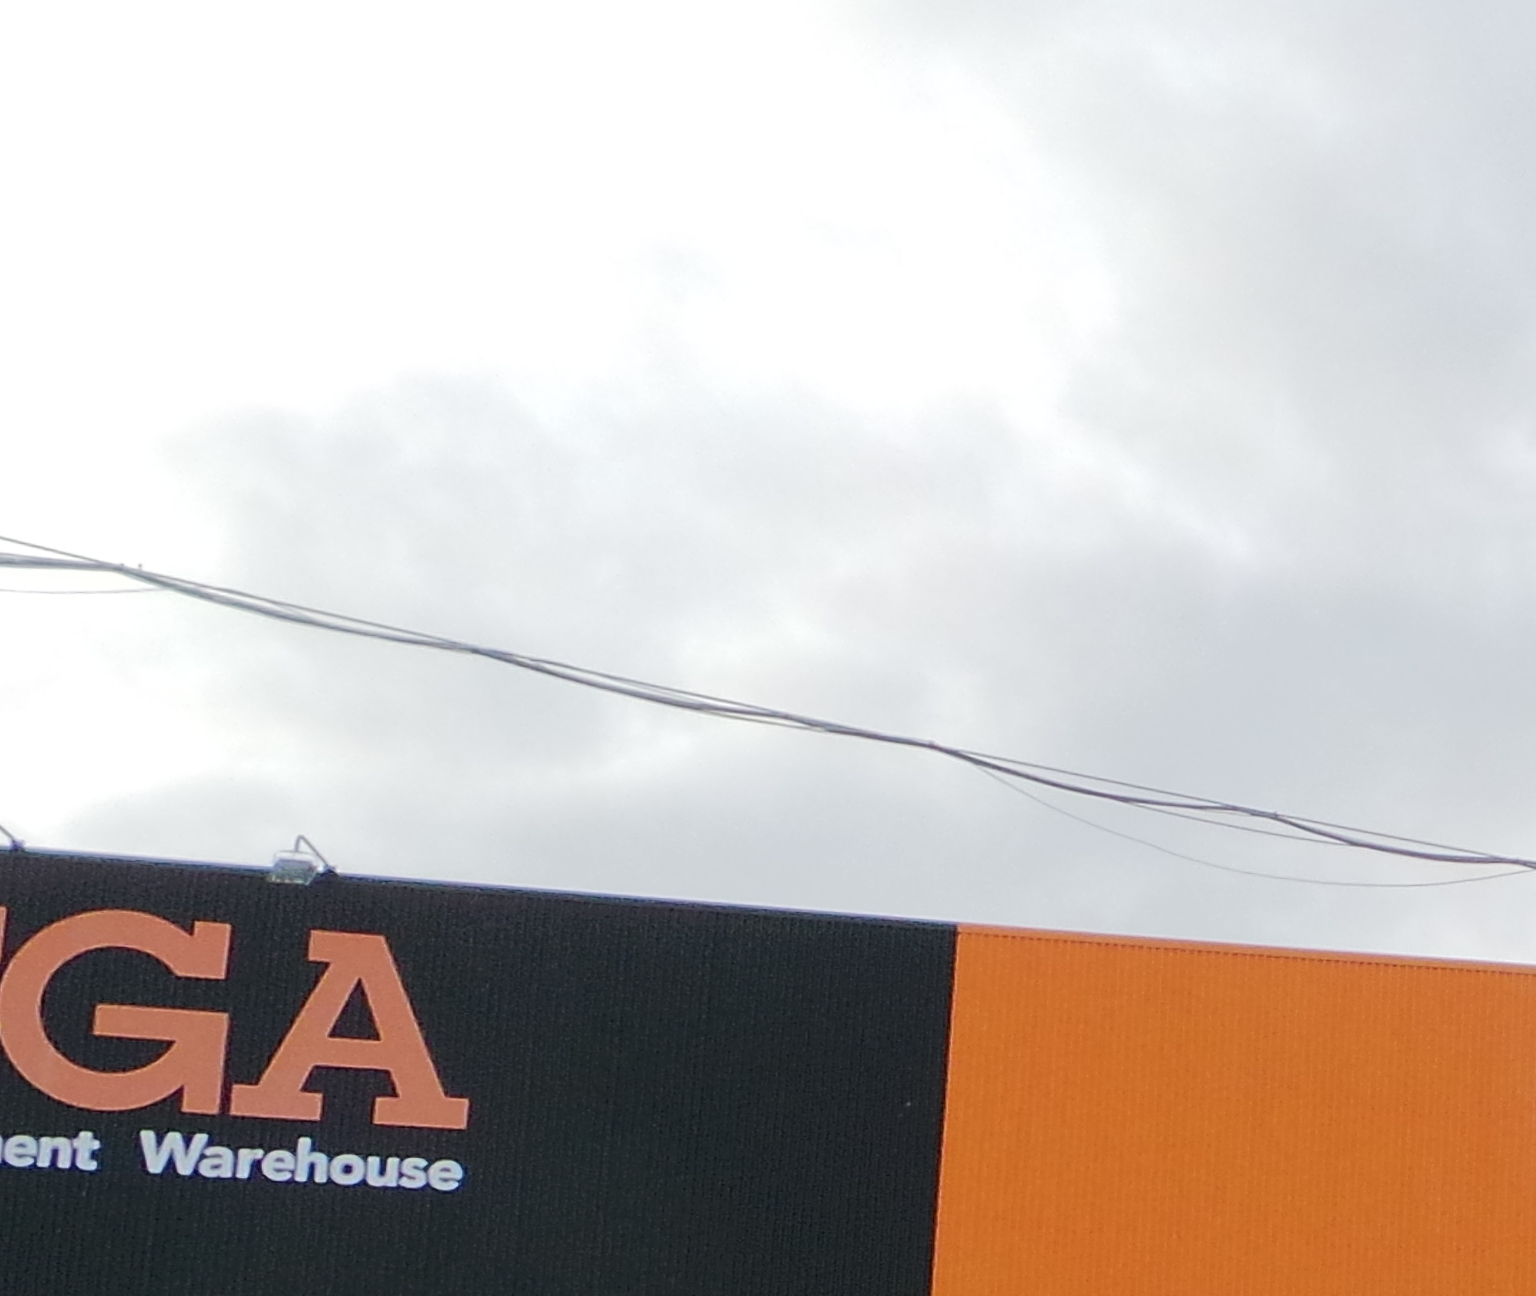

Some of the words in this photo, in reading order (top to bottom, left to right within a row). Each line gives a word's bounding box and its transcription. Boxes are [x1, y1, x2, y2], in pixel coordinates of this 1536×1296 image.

[0, 905, 469, 1130] GA
[0, 1130, 101, 1171] ent
[139, 1129, 465, 1192] Warehouse
